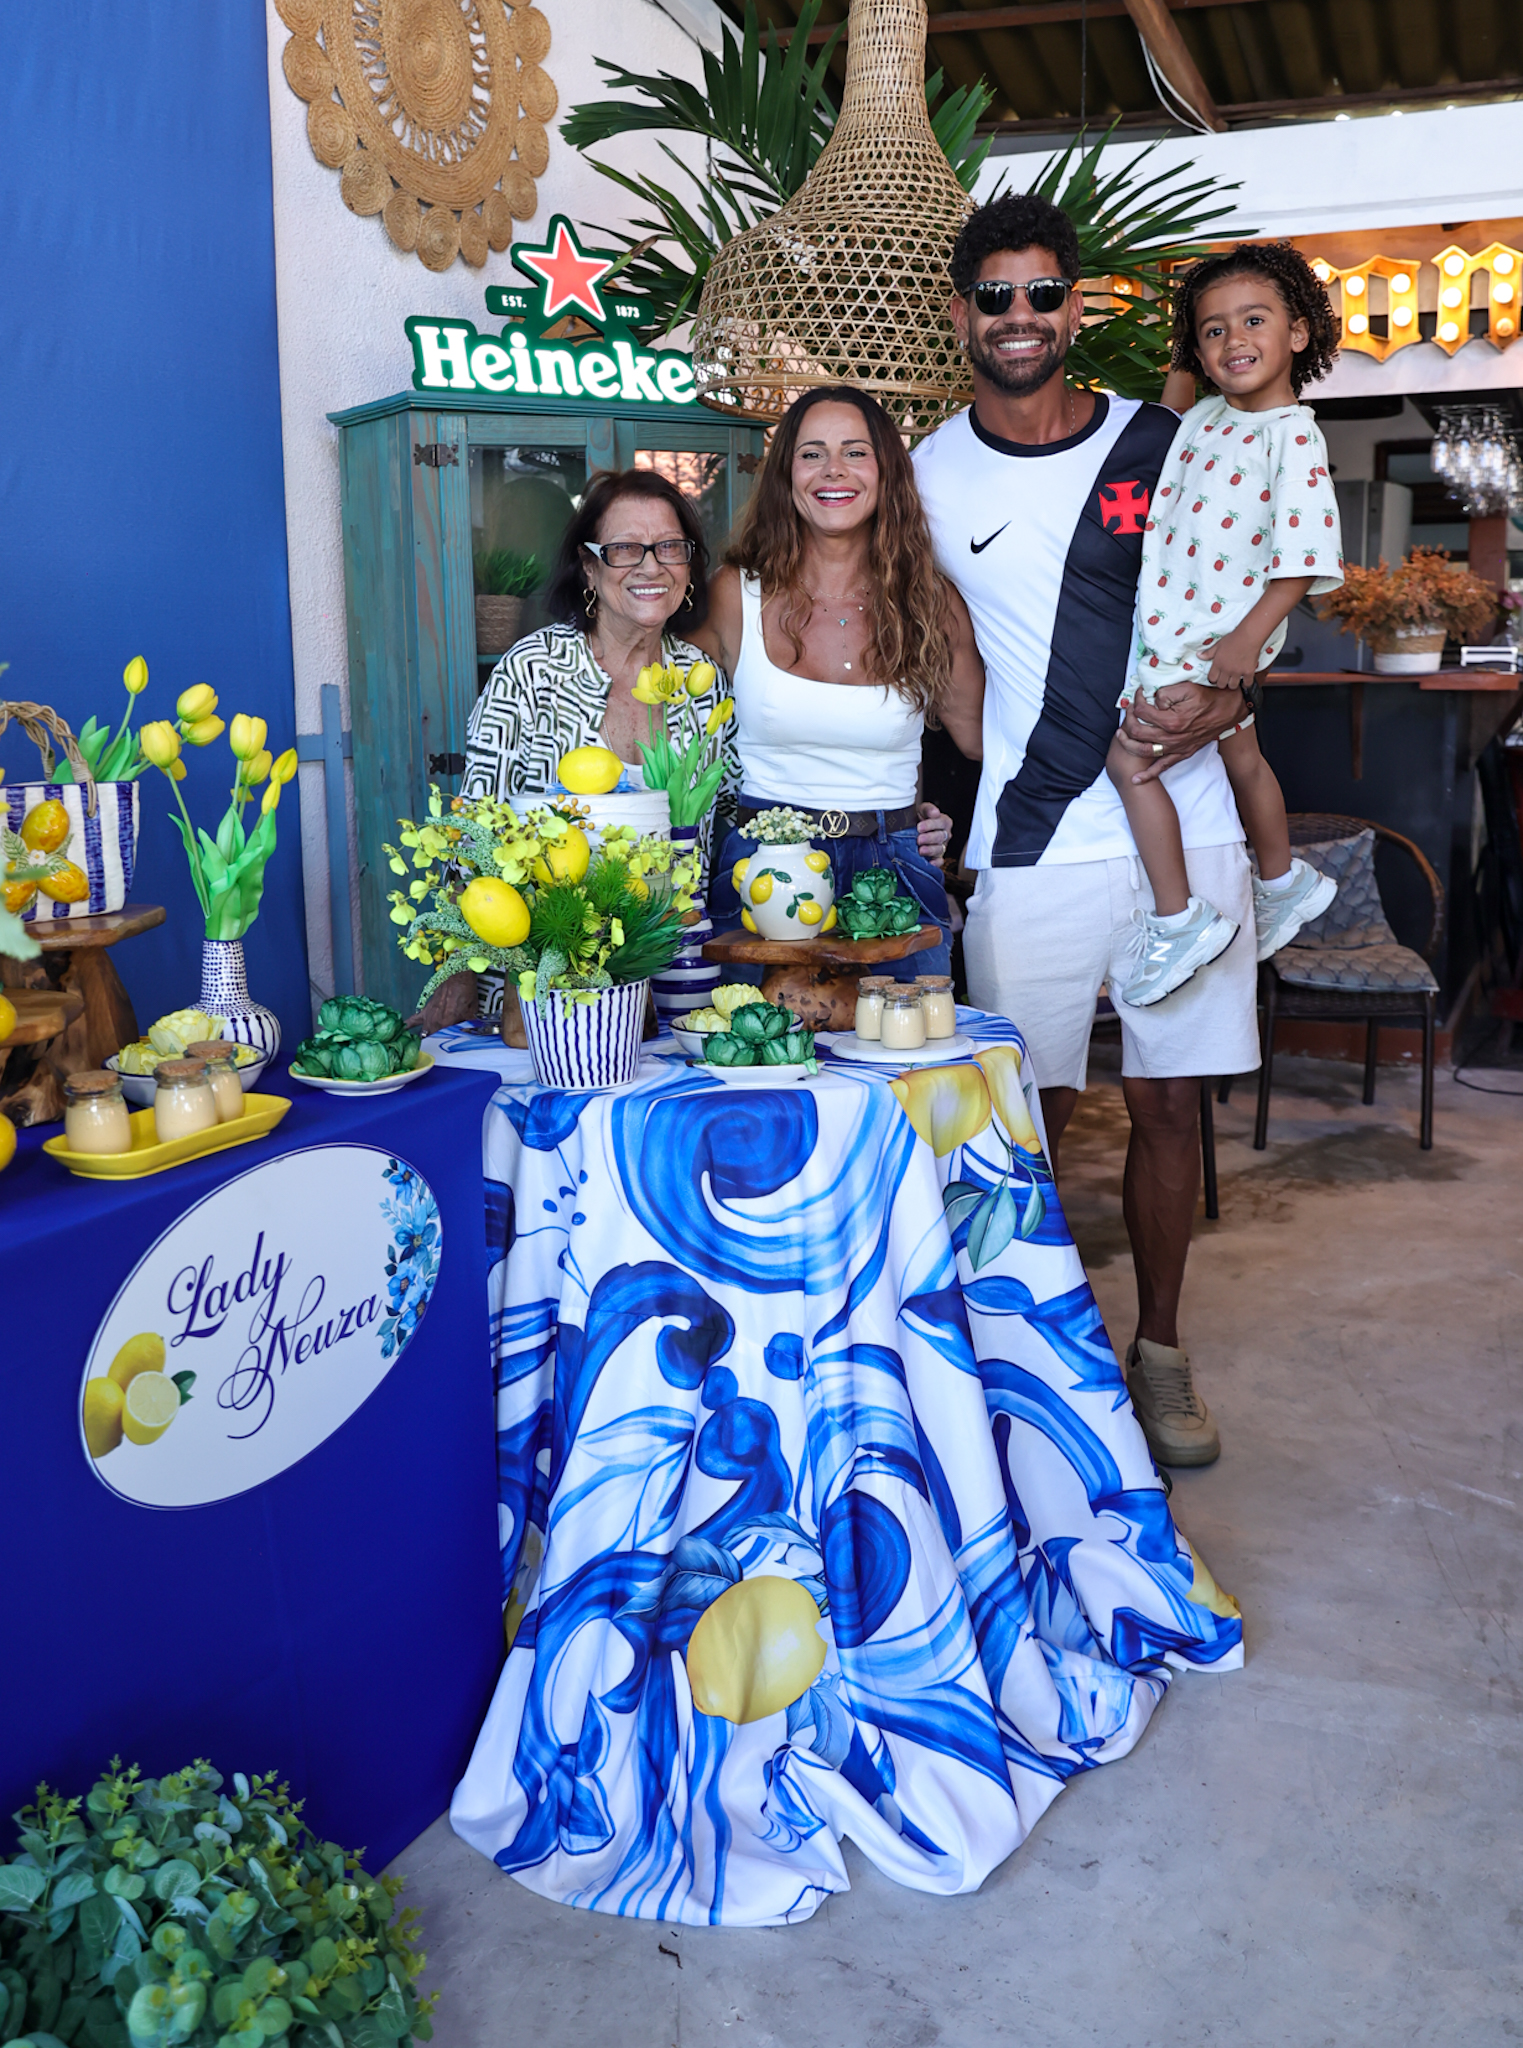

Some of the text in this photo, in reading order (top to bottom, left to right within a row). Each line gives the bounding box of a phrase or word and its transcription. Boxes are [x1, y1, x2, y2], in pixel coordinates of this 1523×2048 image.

[500, 293, 641, 320] EST. 1873
[1149, 941, 1172, 962] N
[167, 1230, 293, 1348] Lady
[217, 1275, 382, 1439] Neuza
